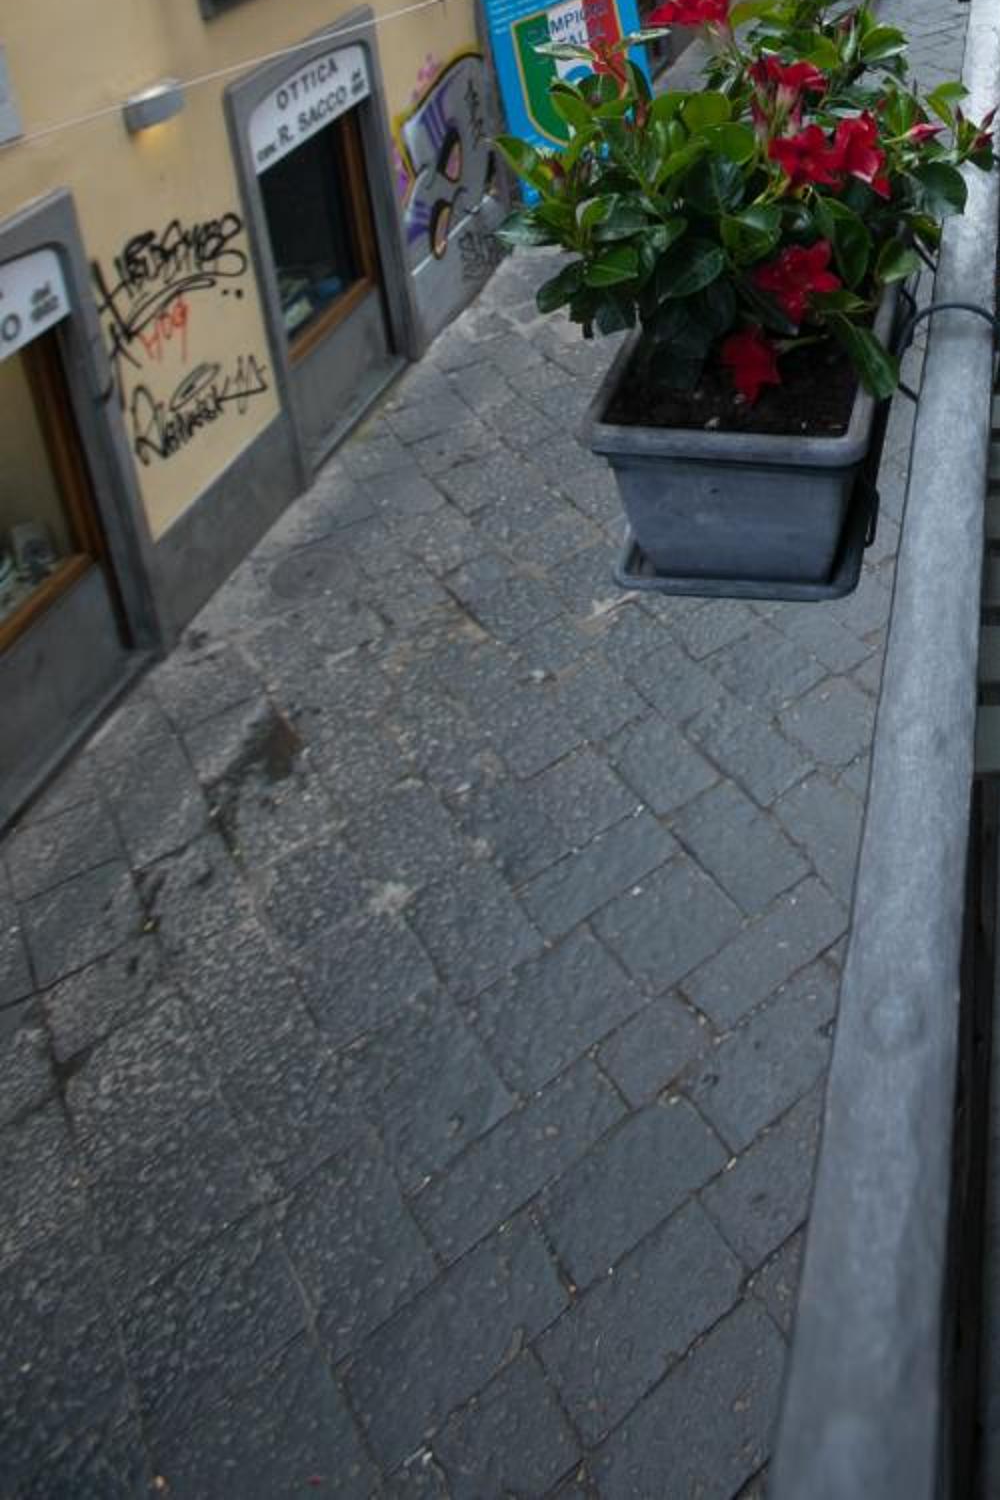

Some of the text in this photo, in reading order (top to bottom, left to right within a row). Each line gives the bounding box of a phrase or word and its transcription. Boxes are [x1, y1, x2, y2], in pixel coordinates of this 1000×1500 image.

[276, 57, 338, 110] OTTICA
[277, 85, 347, 147] R. SACCO
